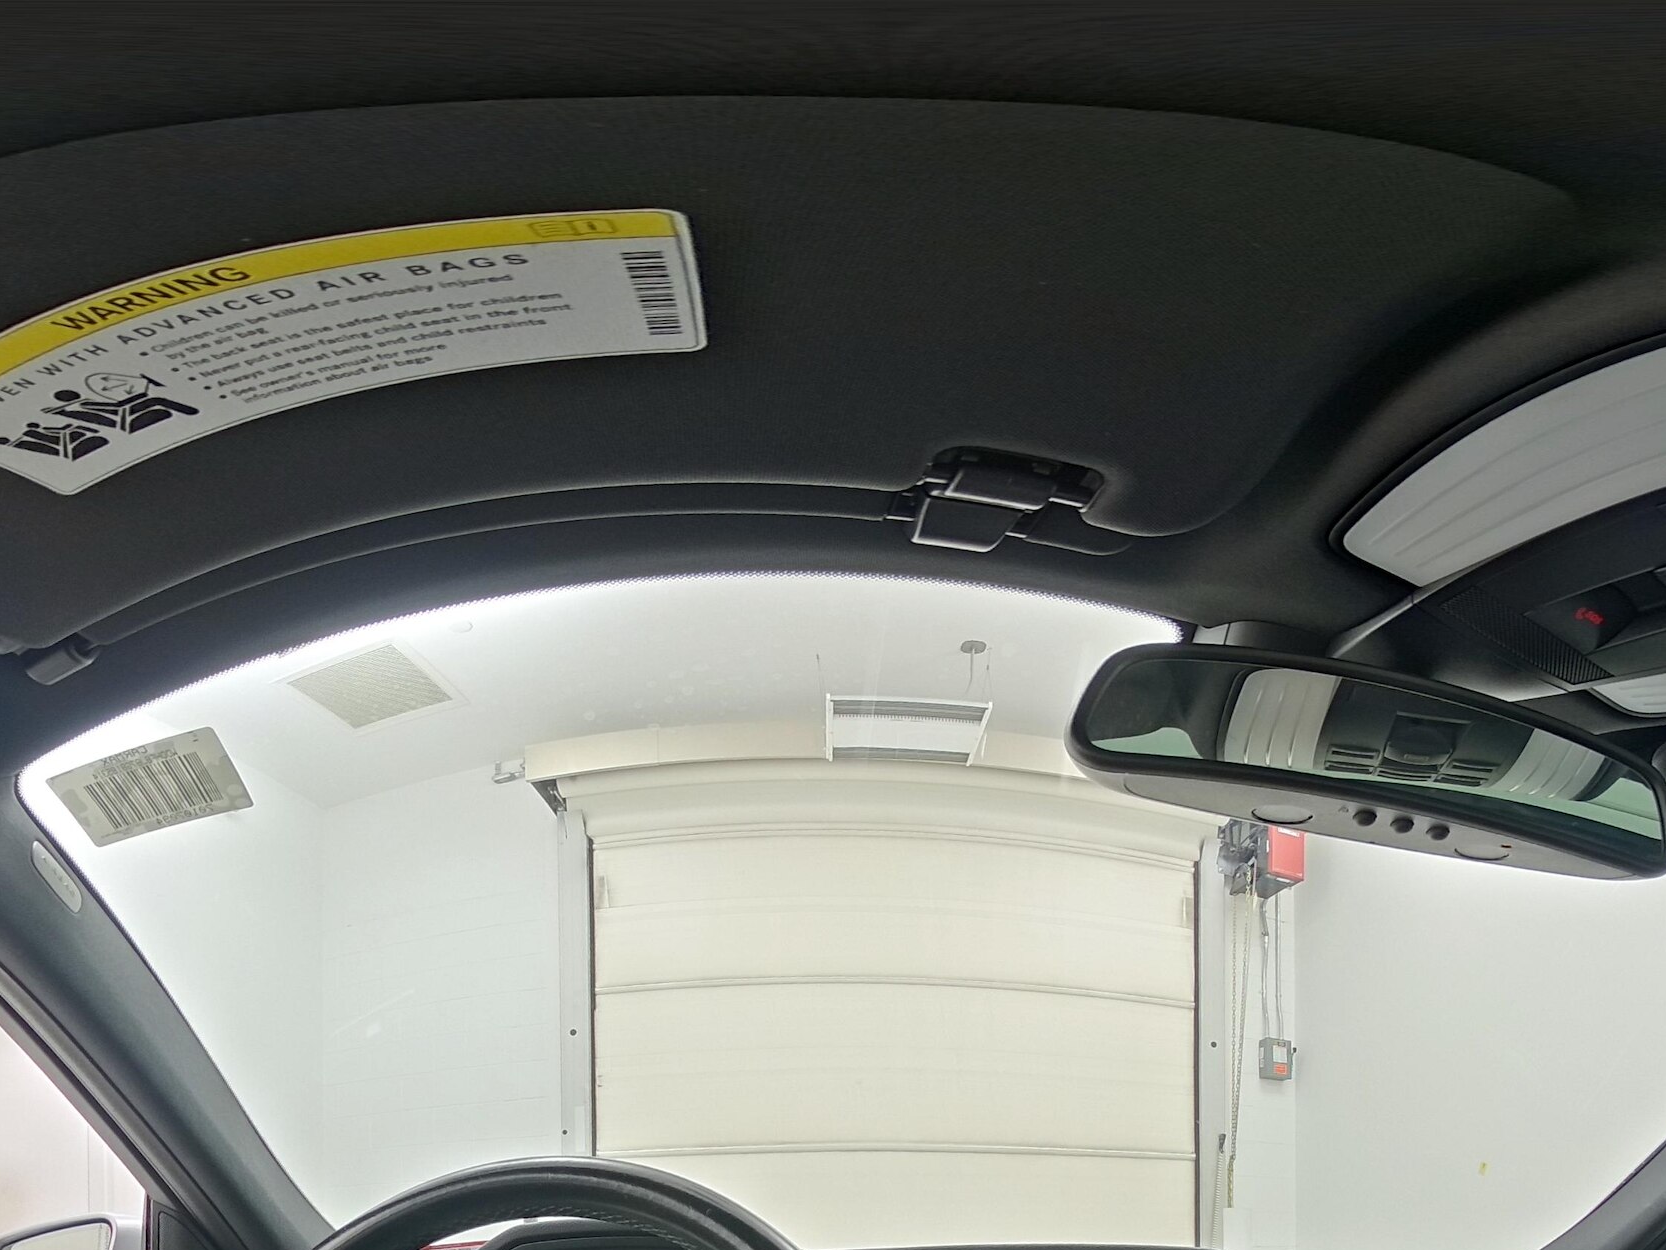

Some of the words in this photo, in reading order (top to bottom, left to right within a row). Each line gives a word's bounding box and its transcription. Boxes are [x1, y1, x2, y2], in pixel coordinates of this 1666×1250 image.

[36, 345, 109, 376] WITH
[116, 288, 296, 345] ADVANCED
[315, 271, 387, 292] AIR
[405, 253, 530, 277] BAGS
[50, 267, 251, 331] WARNING
[150, 331, 214, 353] Children
[215, 322, 246, 334] can
[245, 314, 269, 325] be
[269, 303, 320, 319] killed
[322, 299, 341, 308] or
[346, 284, 434, 303] seriously
[438, 273, 514, 289] injured
[182, 357, 211, 370] The
[211, 346, 248, 360] back
[250, 336, 284, 350] seat
[286, 331, 302, 341] is
[303, 325, 334, 337] the
[336, 312, 390, 329] safest
[393, 305, 444, 321] place
[446, 302, 475, 311] for
[479, 292, 564, 307] children
[166, 351, 186, 362] by
[186, 342, 212, 354] the
[214, 335, 233, 346] air
[235, 327, 269, 339] bag
[200, 362, 242, 378] Never
[244, 354, 271, 367] put
[373, 322, 417, 336] child
[420, 315, 460, 327] seat
[464, 312, 482, 321] in
[486, 308, 519, 319] the
[521, 303, 573, 315] front
[216, 370, 265, 388] Always
[267, 362, 294, 373] use
[296, 352, 331, 366] seat
[331, 343, 373, 358] belts
[376, 337, 409, 348] and
[410, 328, 454, 342] child
[456, 318, 547, 335] restraints
[230, 385, 258, 397] See
[259, 371, 315, 389] owner's
[316, 355, 374, 374] manual
[375, 351, 400, 361] for
[403, 342, 447, 356] more
[241, 378, 323, 404] information
[325, 368, 368, 382] about
[370, 362, 391, 372] air
[393, 355, 434, 367] bags
